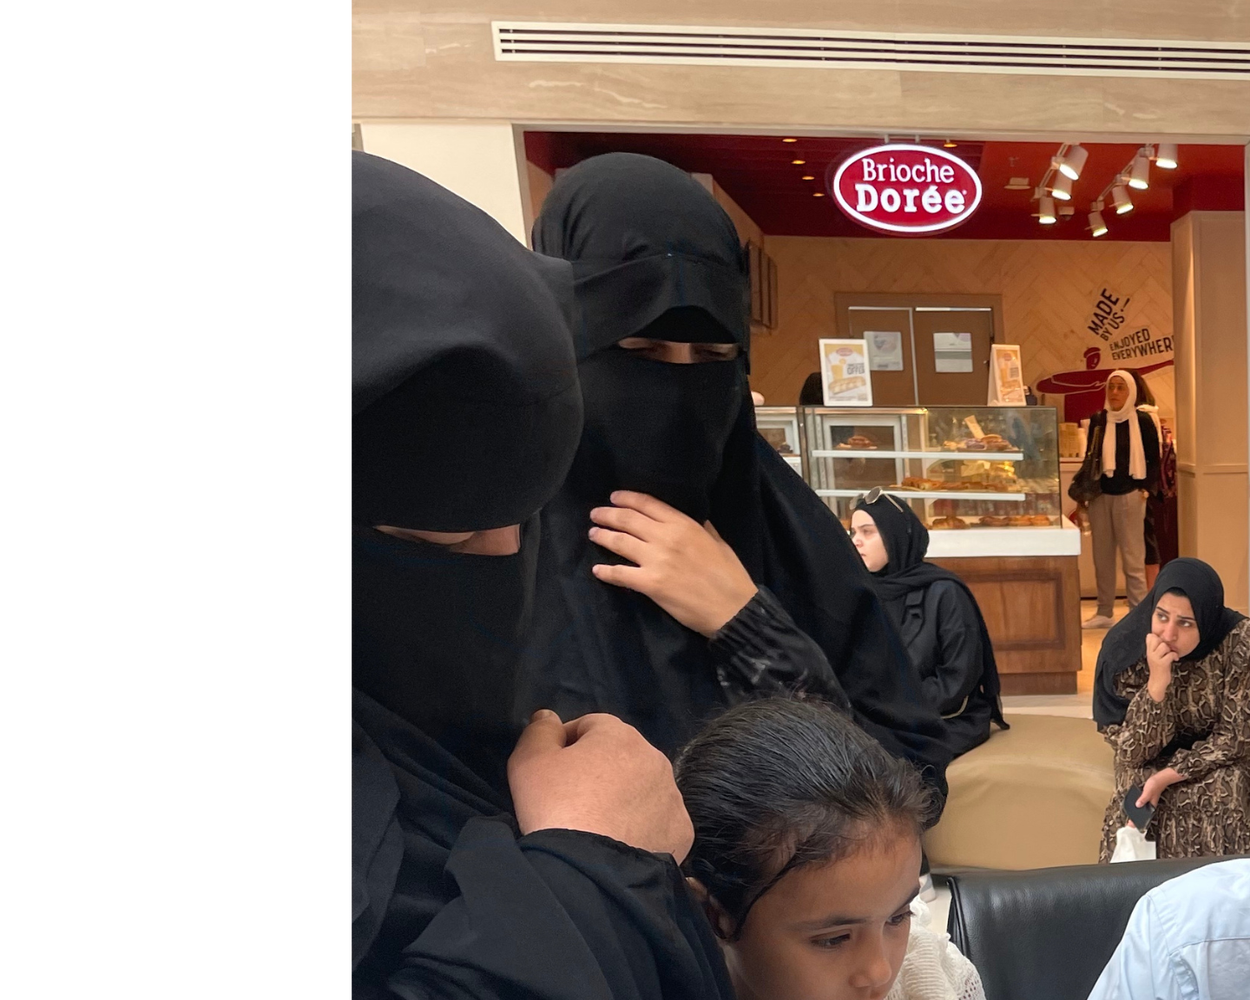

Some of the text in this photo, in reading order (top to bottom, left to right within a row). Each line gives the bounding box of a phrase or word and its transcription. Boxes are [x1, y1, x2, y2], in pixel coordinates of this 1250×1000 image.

[862, 157, 955, 183] Brioche
[854, 183, 966, 214] Dorée
[1087, 288, 1120, 335] MADE
[1100, 327, 1113, 341] BY
[1109, 328, 1151, 351] ENJOYED
[1111, 335, 1174, 360] EVERYWHER
